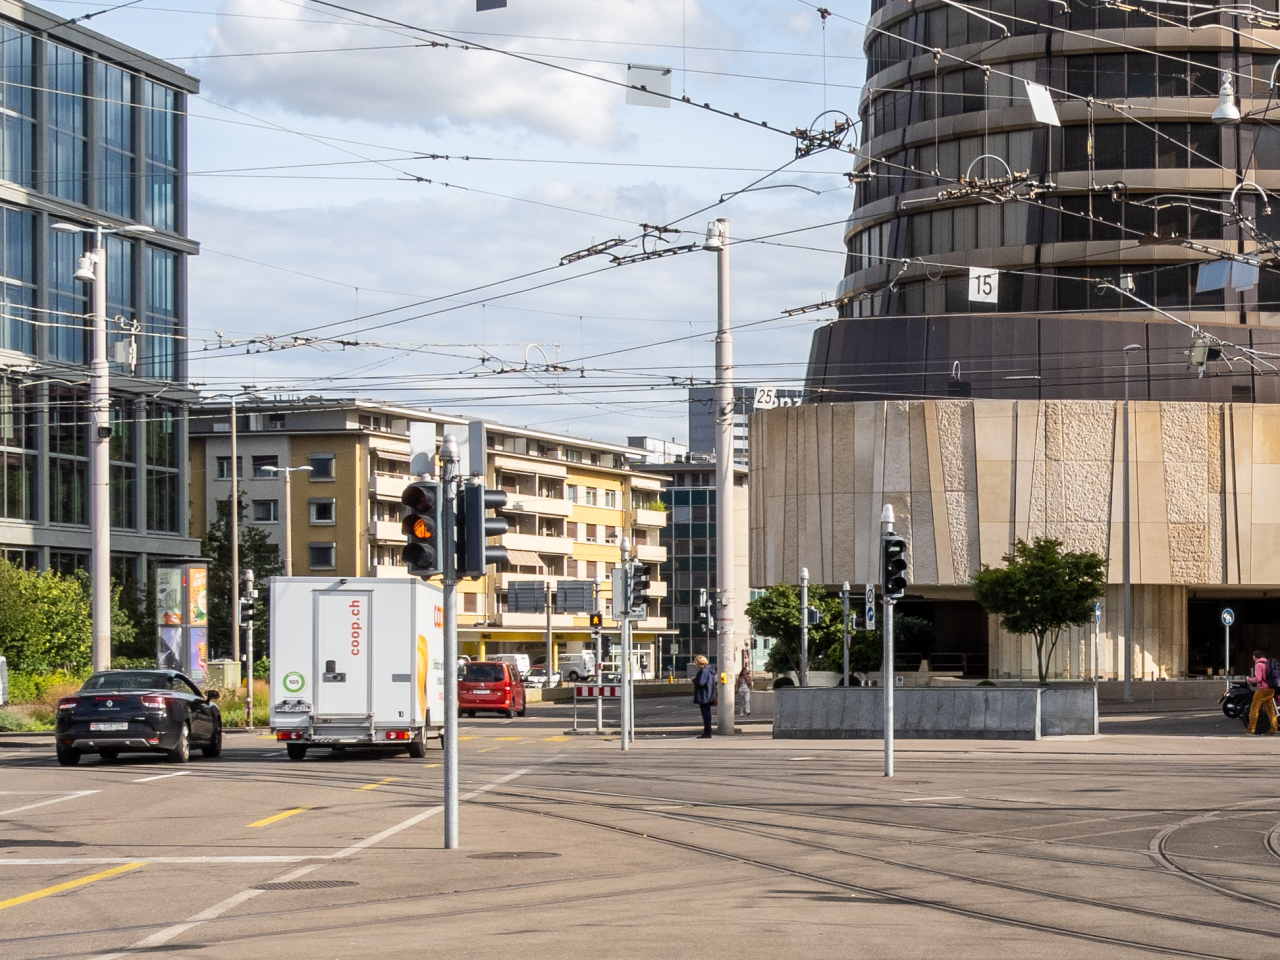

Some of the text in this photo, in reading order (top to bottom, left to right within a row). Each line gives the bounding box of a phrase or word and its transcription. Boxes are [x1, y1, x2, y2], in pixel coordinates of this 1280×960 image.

[975, 274, 993, 296] 15
[757, 388, 773, 404] 25
[349, 599, 362, 656] coop.ch
